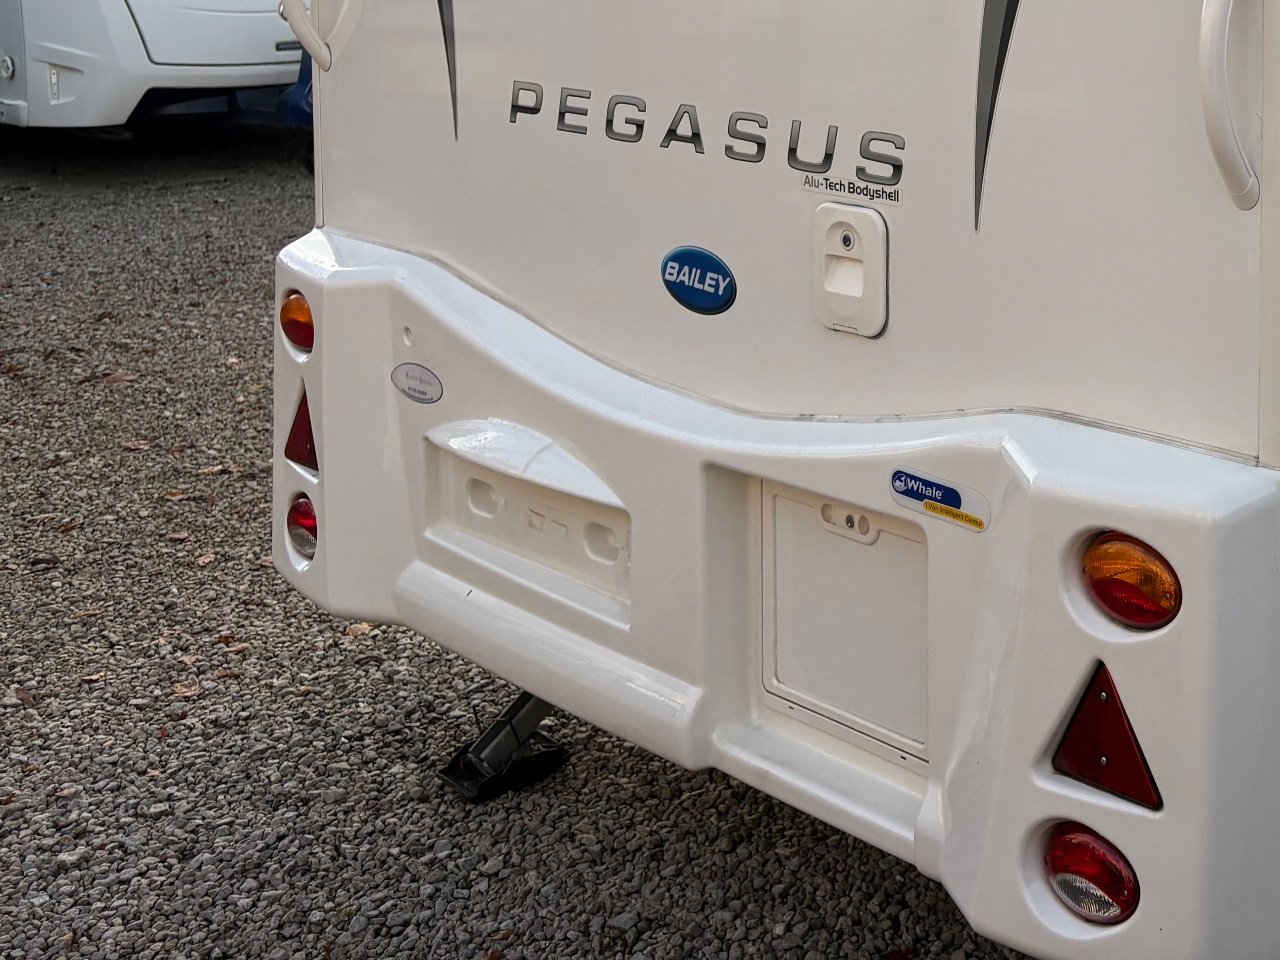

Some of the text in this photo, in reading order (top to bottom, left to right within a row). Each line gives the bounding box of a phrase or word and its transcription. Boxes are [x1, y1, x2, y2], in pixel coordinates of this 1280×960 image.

[508, 80, 906, 186] PEGASUS
[803, 174, 900, 202] Alu-Tech Bodyshell
[663, 260, 731, 296] BAILEY
[906, 477, 942, 499] Whale
